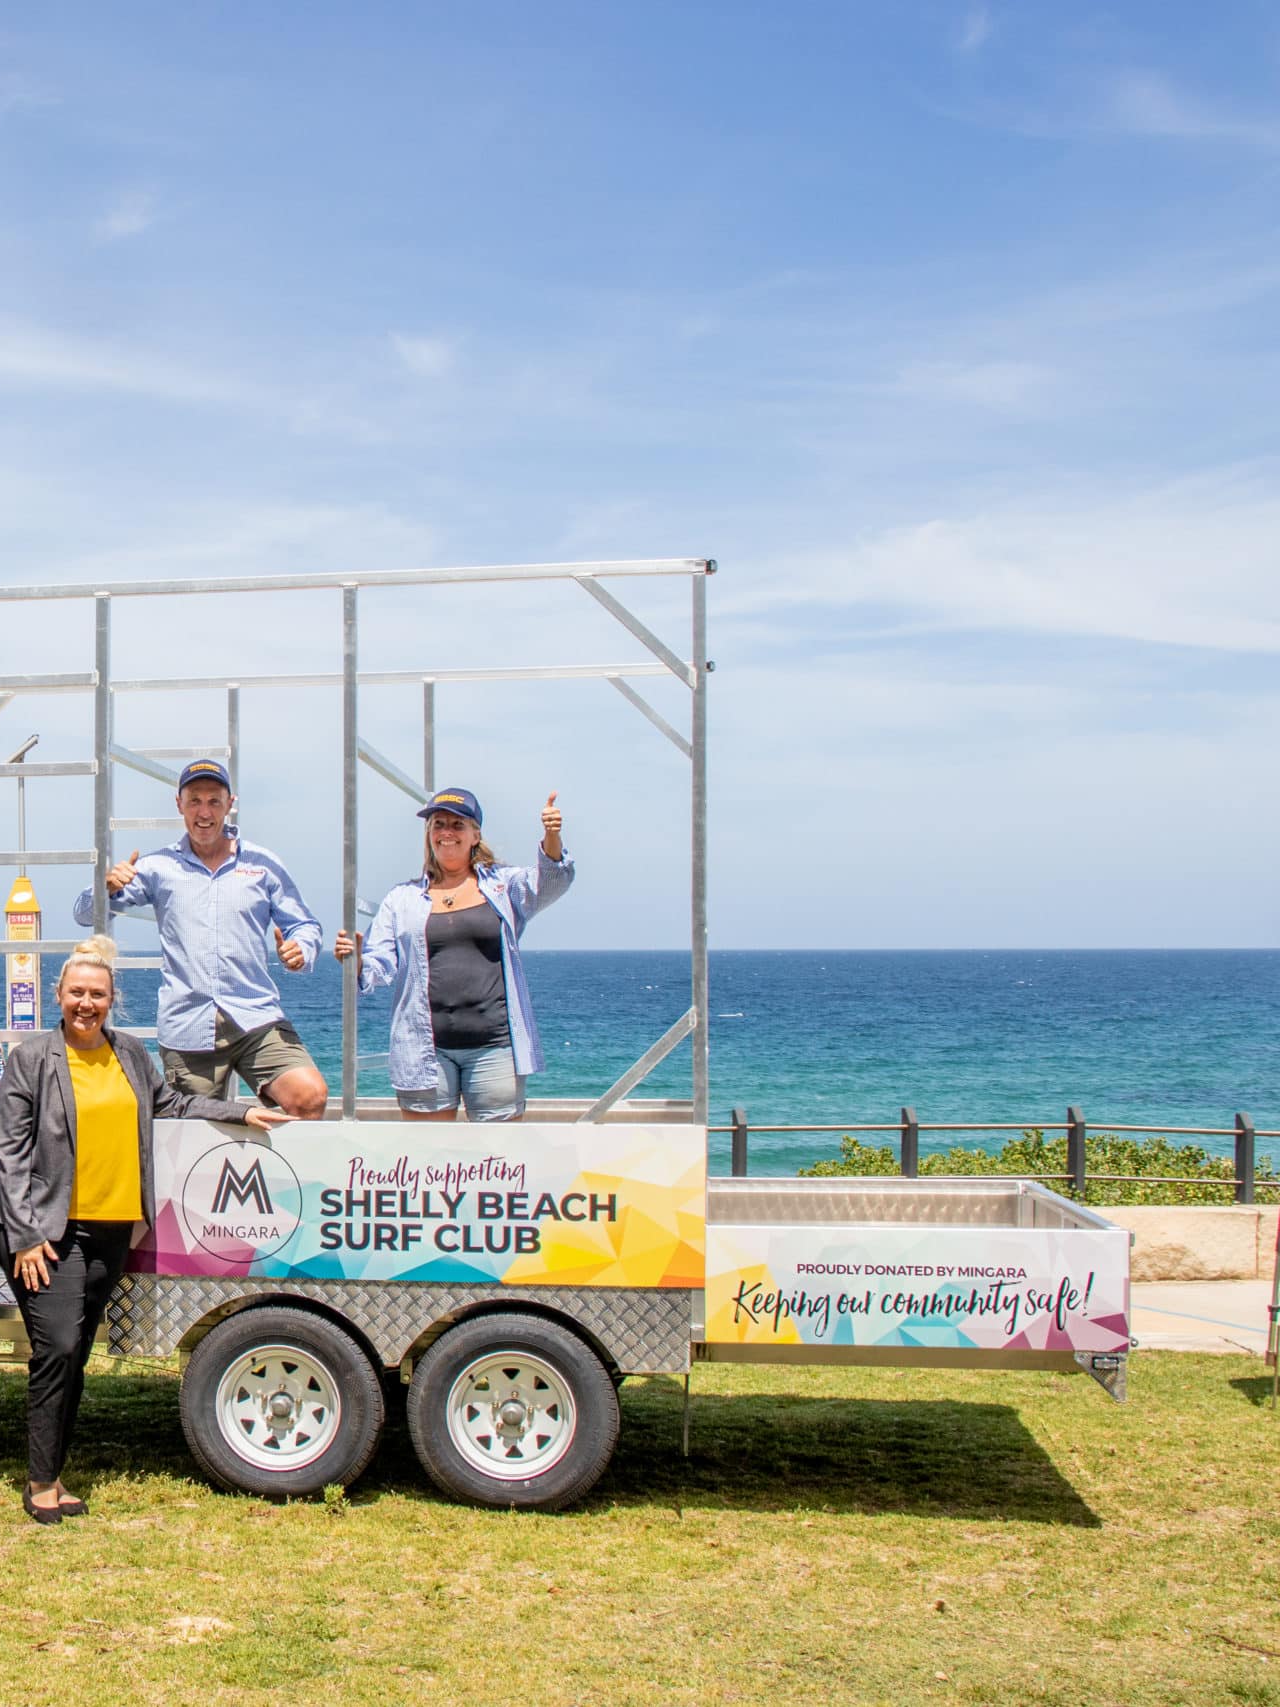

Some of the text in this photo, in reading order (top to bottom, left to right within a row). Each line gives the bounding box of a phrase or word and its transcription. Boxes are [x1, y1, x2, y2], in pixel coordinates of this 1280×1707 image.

[211, 1157, 274, 1214] M
[349, 1155, 526, 1199] Proudly supporting
[320, 1189, 617, 1222] SHELLY BEACH
[202, 1225, 280, 1239] MINGARA
[320, 1222, 541, 1254] SURF CLUB
[797, 1263, 1027, 1278] PROUDLY DONATED BY MINGARA
[732, 1272, 1095, 1338] Keeping our community safe!
